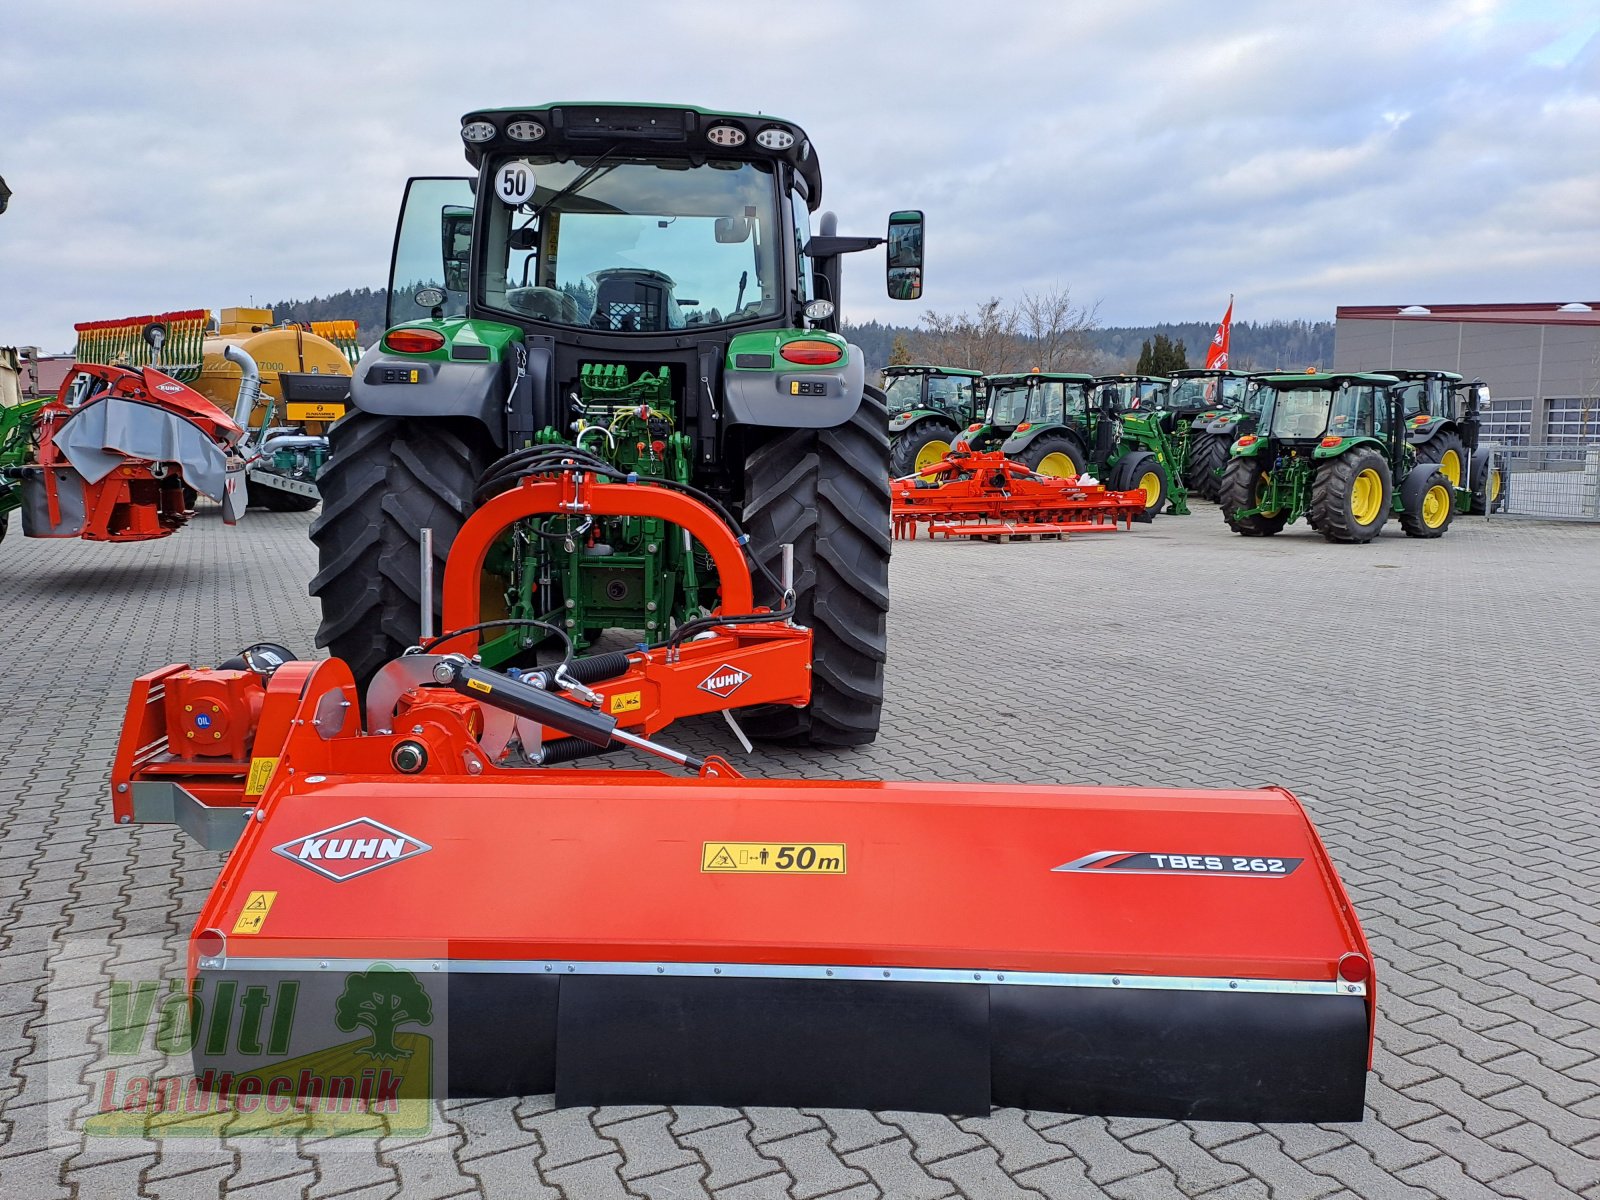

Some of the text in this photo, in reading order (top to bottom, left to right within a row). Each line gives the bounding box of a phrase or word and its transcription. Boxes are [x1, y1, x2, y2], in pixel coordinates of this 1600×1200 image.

[504, 170, 526, 196] 50
[707, 672, 743, 690] KUHN
[197, 716, 210, 726] OIL
[298, 838, 406, 859] KUHN
[775, 846, 840, 870] 50 m
[1150, 854, 1286, 873] TBES 262
